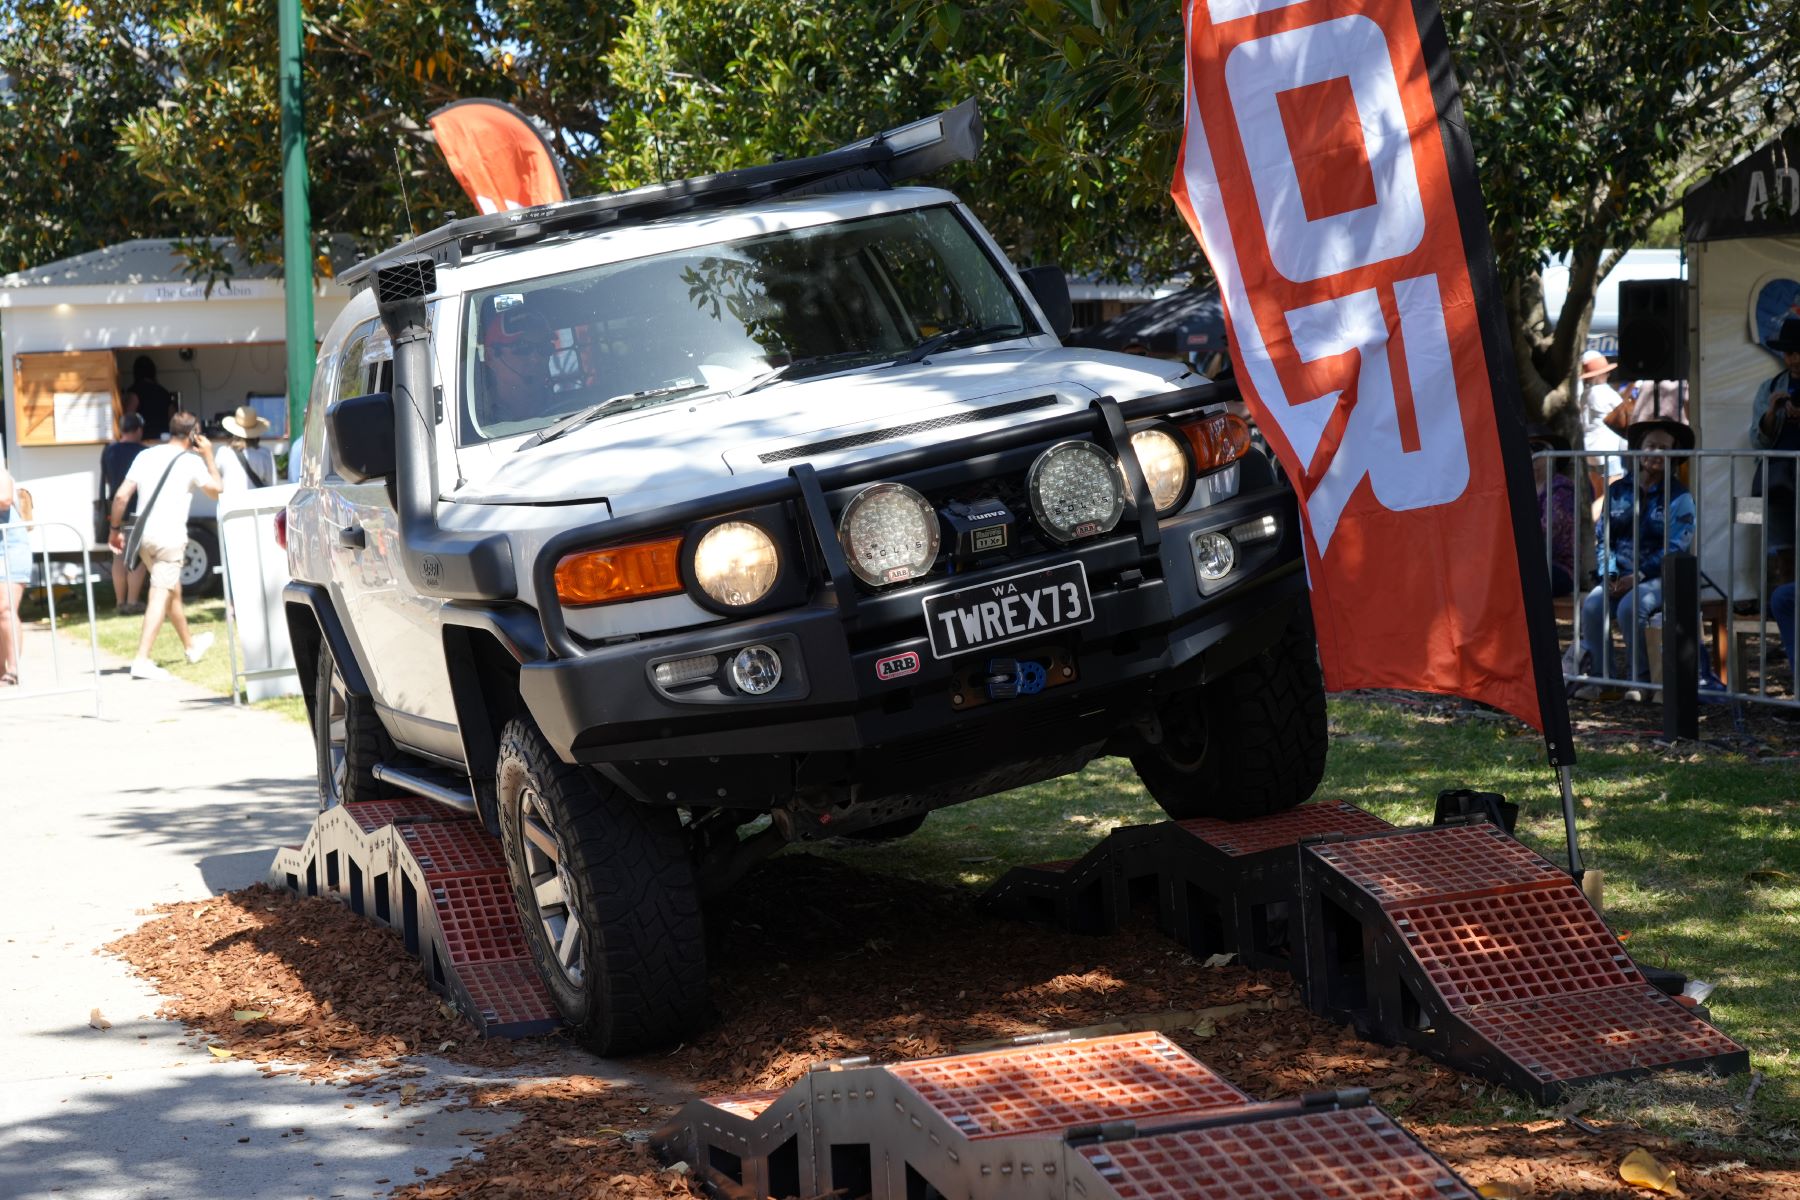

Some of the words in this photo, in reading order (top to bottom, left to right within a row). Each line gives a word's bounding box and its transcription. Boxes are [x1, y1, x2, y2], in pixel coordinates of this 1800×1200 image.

[155, 286, 176, 298] The
[218, 284, 252, 297] Cabin
[1055, 496, 1109, 516] SOLIS
[967, 510, 1006, 521] Runva
[866, 541, 922, 560] SOLIS
[891, 569, 908, 578] ARB
[992, 582, 1018, 597] WA
[938, 582, 1082, 649] TWREX73
[882, 657, 916, 676] ARB
